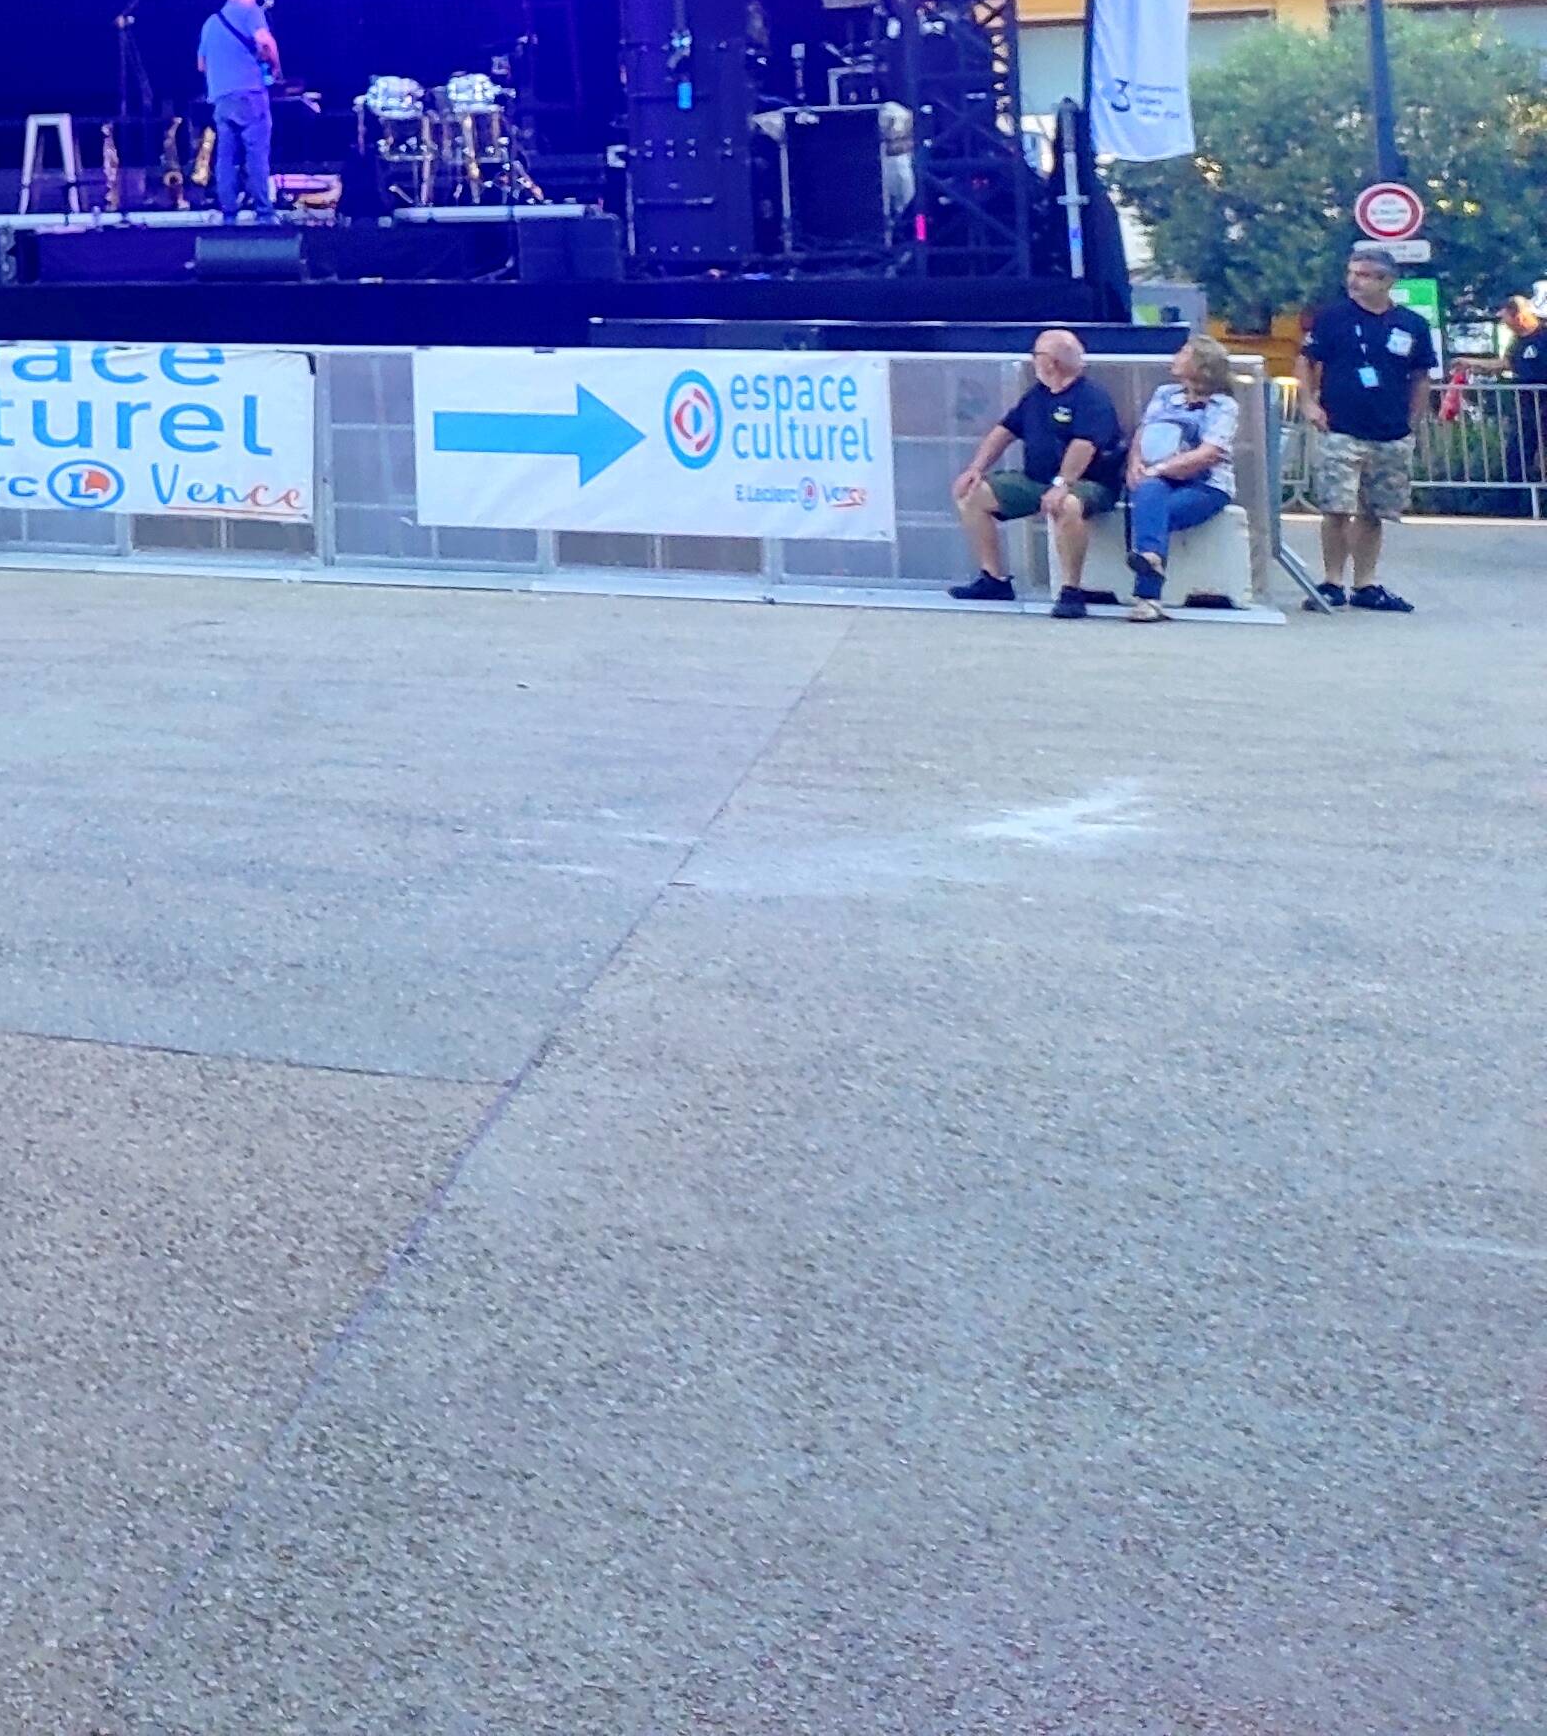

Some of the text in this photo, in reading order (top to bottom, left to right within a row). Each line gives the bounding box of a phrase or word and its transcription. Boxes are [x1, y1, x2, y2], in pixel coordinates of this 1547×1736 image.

[730, 374, 858, 413] espace
[732, 416, 874, 463] culturel
[151, 462, 304, 510] Vence
